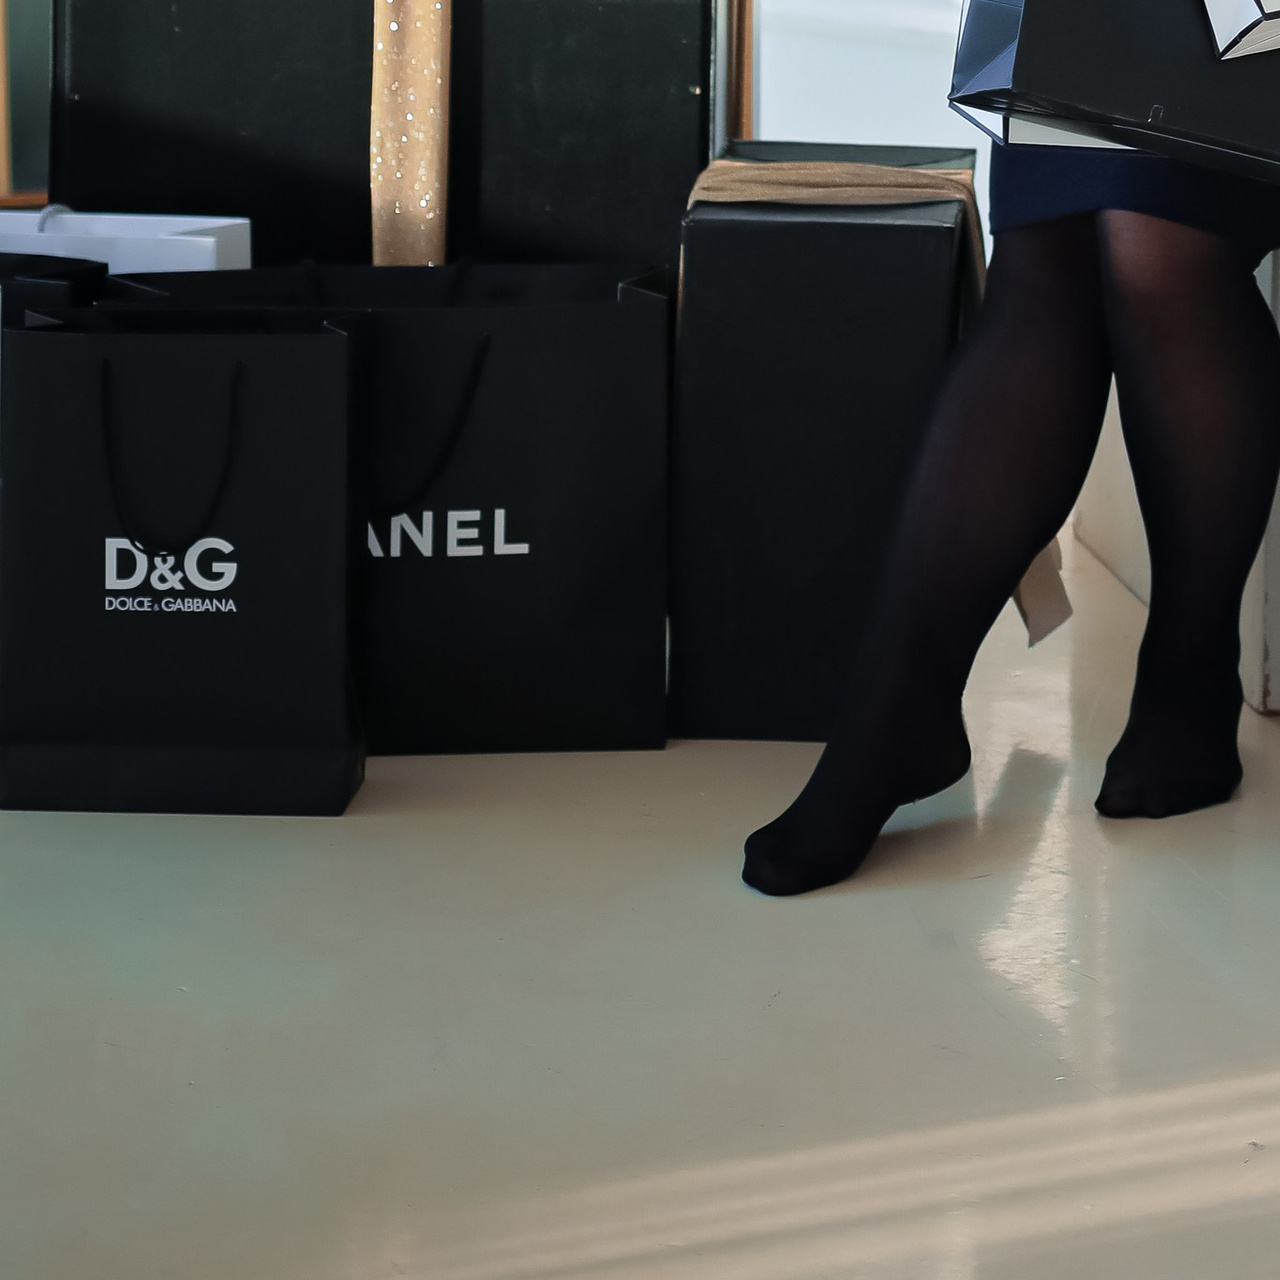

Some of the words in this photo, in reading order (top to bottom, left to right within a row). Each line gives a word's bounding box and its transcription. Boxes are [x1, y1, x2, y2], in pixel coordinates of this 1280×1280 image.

[105, 537, 238, 591] D&G
[105, 597, 152, 611] DOLCE
[161, 598, 237, 612] GABBANA
